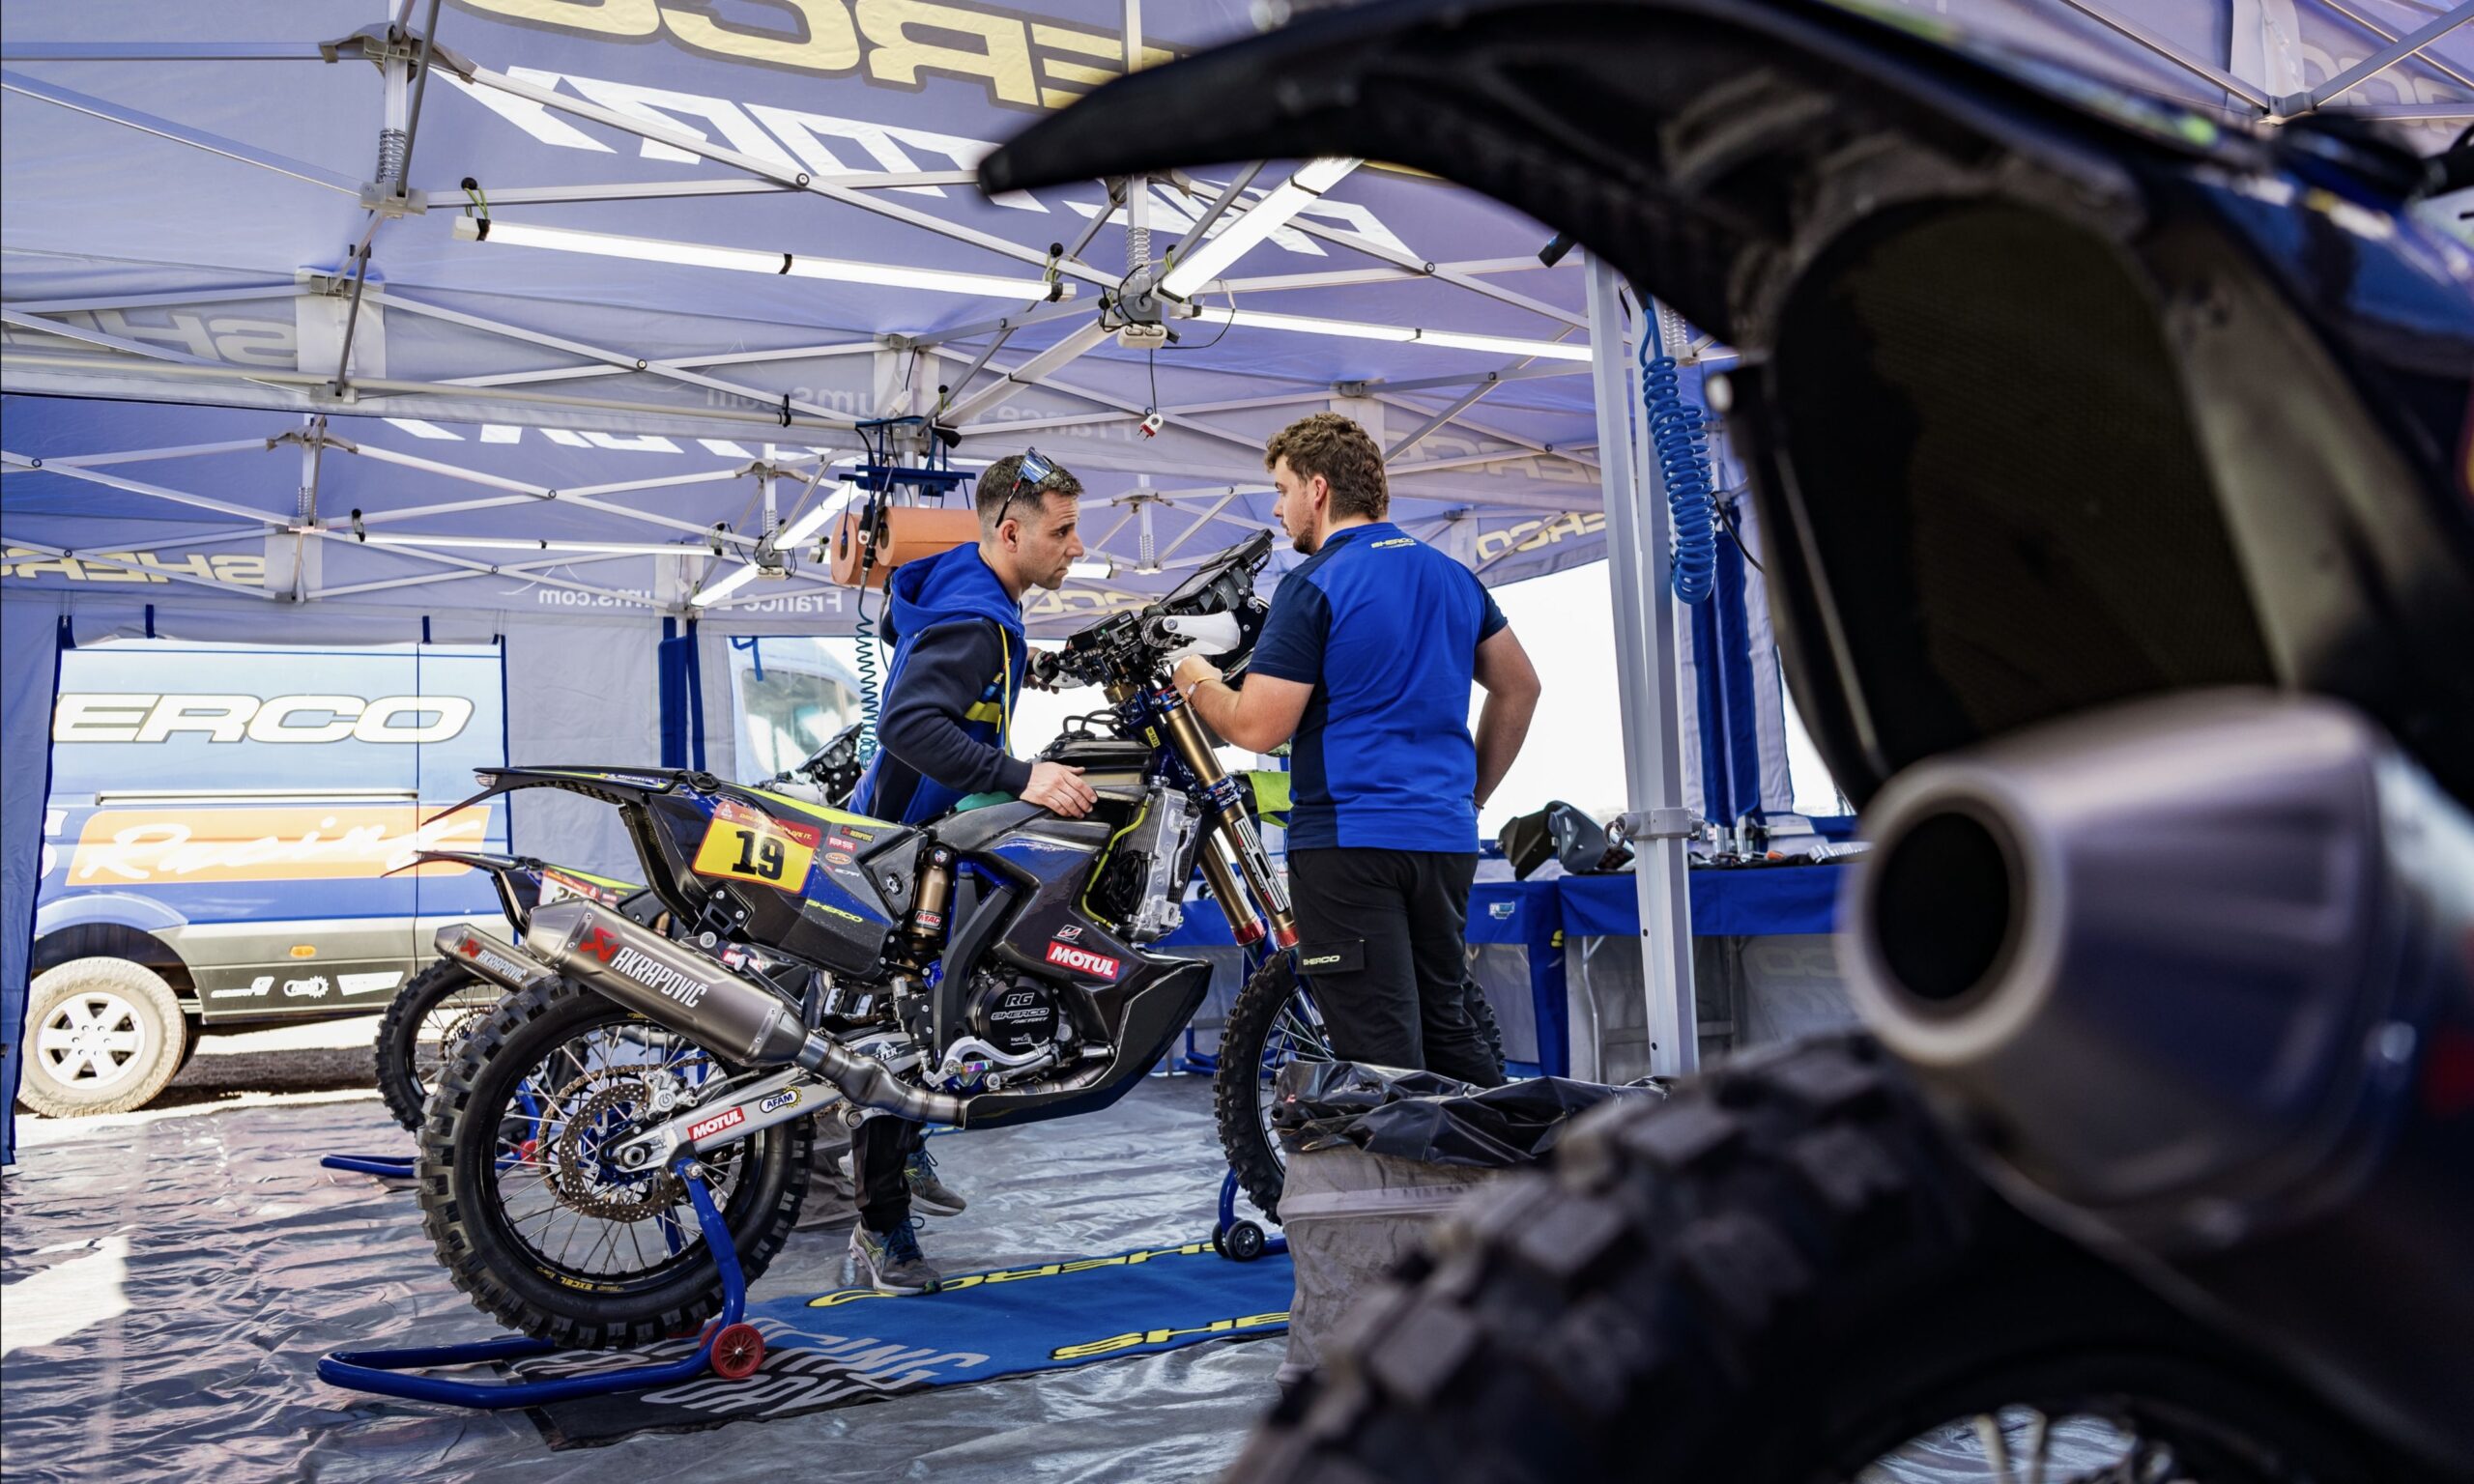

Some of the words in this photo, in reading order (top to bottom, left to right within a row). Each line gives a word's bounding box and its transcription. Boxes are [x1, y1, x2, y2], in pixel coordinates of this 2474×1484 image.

[53, 691, 475, 745] ERCO
[732, 830, 786, 881] 19
[806, 899, 864, 924] SHERCO
[1050, 945, 1114, 977] MOTUL
[609, 946, 710, 1009] AKRAPOVIČ
[991, 1007, 1050, 1021] SHERCO
[1005, 992, 1035, 1008] RG
[765, 1092, 794, 1110] AFAM
[691, 1108, 743, 1140] MOTUL
[561, 1276, 593, 1291] EXCEL
